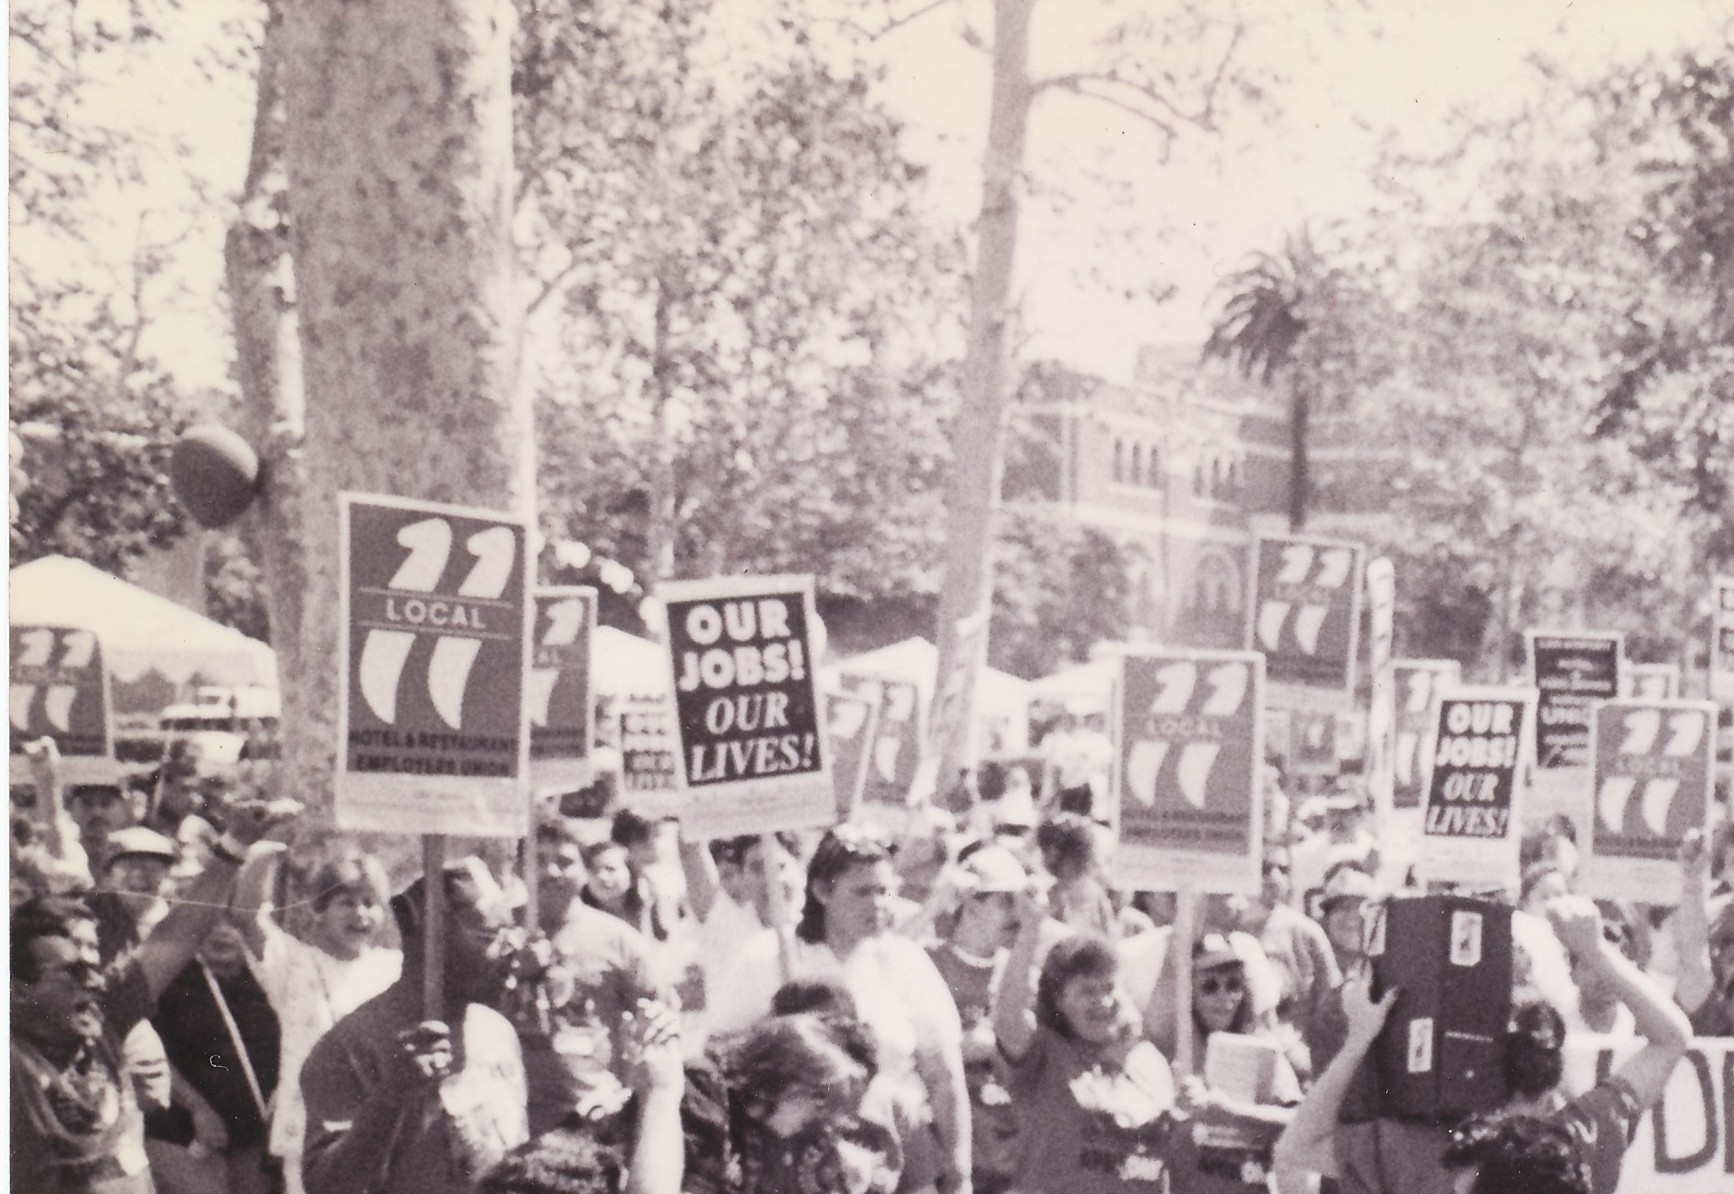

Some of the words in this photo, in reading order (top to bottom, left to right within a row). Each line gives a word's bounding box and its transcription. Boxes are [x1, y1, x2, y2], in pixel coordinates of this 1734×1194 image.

[386, 599, 486, 630] LOCAL
[686, 599, 792, 645] OUR
[679, 638, 806, 692] JOBS!
[706, 690, 790, 735] OUR
[1145, 717, 1224, 739] LOCAL
[1447, 702, 1515, 735] OUR
[690, 733, 817, 782] LIVES!
[1436, 735, 1517, 769] JOBS!
[1443, 771, 1499, 802] OUR
[1426, 805, 1510, 837] LIVES!
